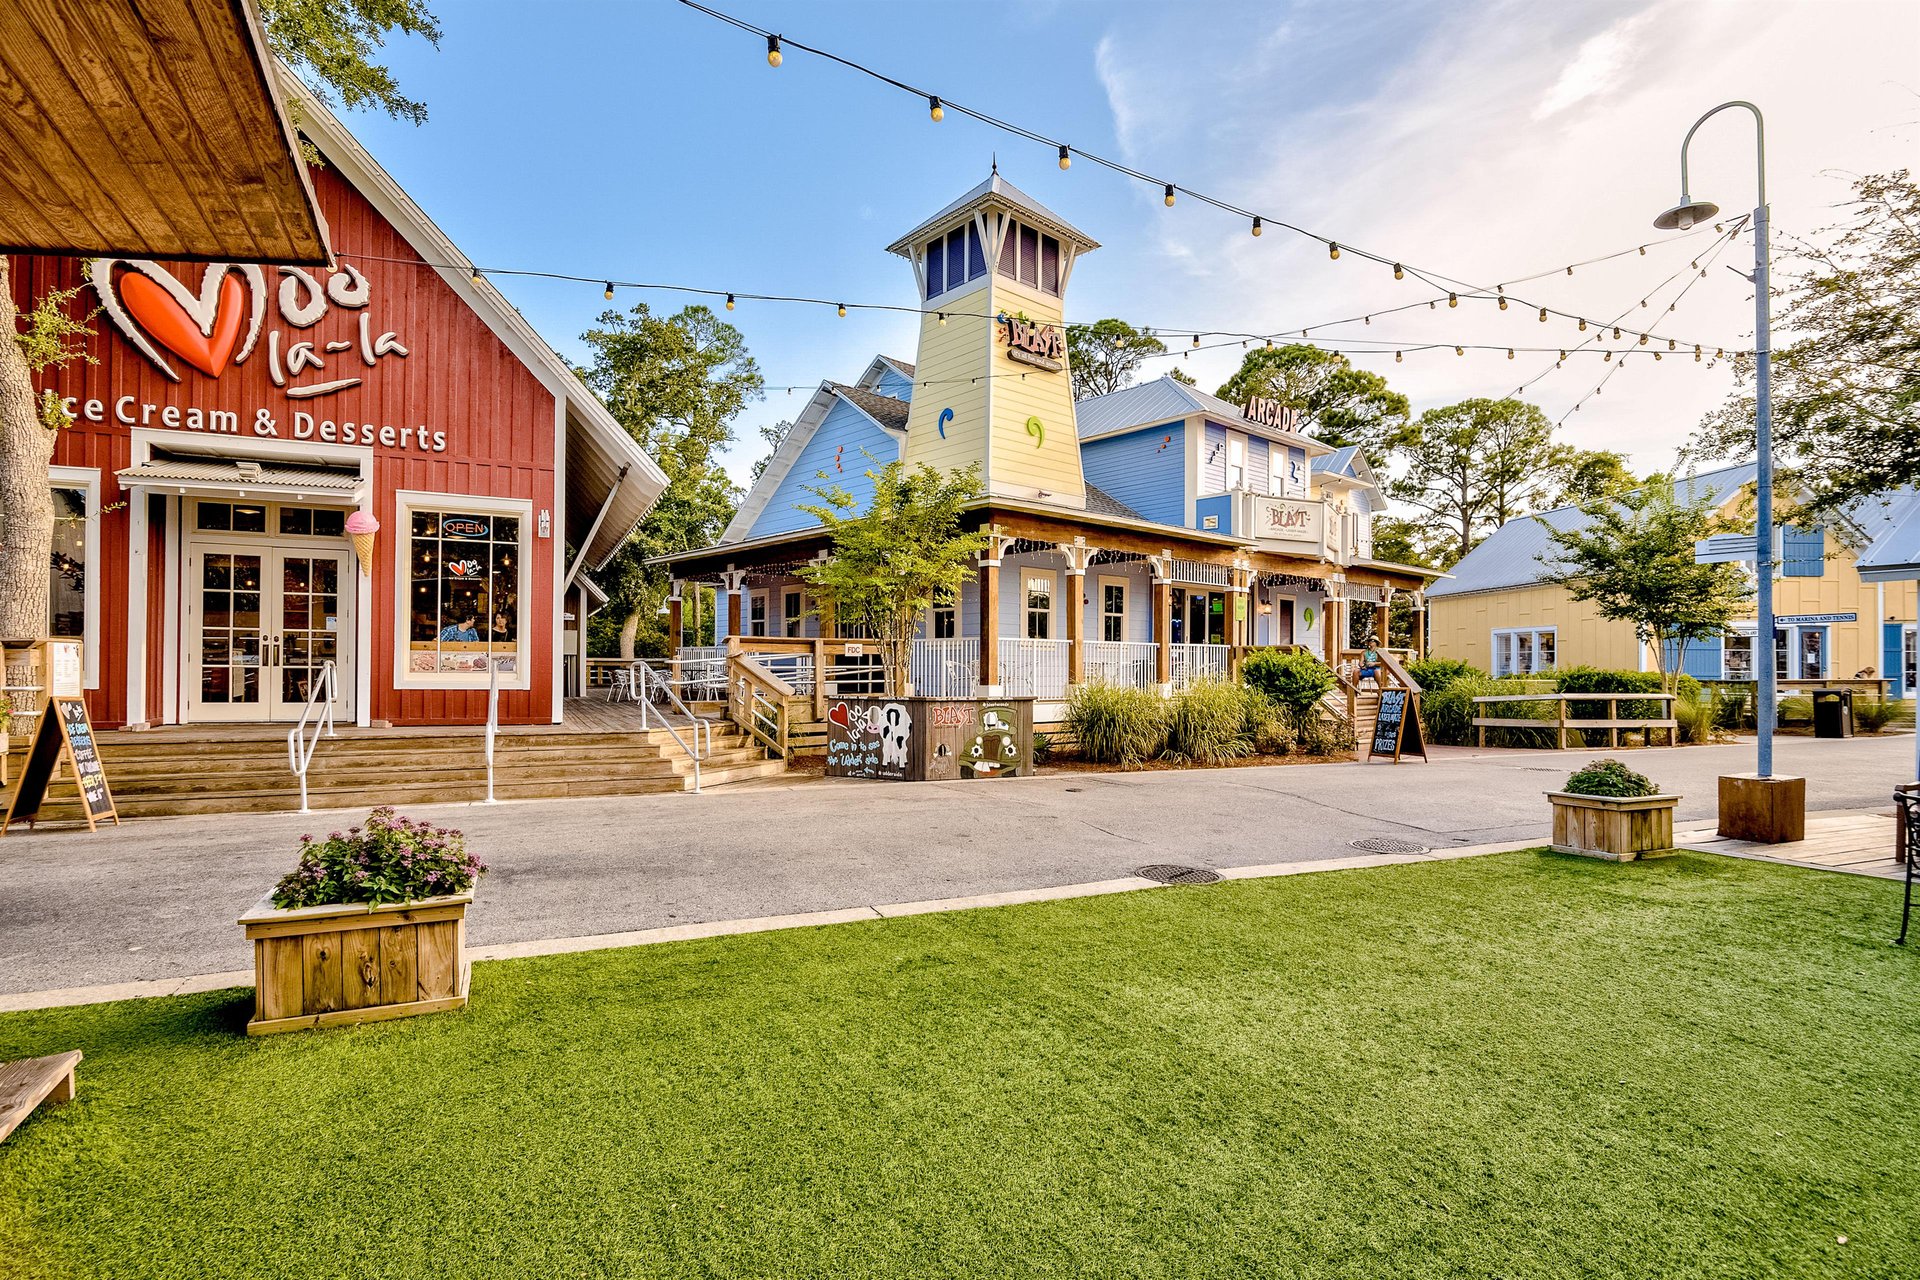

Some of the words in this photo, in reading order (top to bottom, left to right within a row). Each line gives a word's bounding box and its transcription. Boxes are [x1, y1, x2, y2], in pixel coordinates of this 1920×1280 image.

[268, 312, 410, 386] la-la
[1009, 319, 1062, 359] BLAST
[115, 395, 238, 433] Cream
[253, 408, 278, 437] &
[293, 411, 447, 452] Desserts
[1247, 395, 1298, 433] ARCADE
[445, 523, 485, 533] OPEN
[1270, 508, 1308, 528] BLAST
[847, 646, 860, 654] FDC
[933, 703, 974, 729] BLAST
[829, 739, 849, 752] Come
[851, 742, 858, 751] in
[868, 740, 880, 751] see
[1374, 738, 1396, 751] PRIZES
